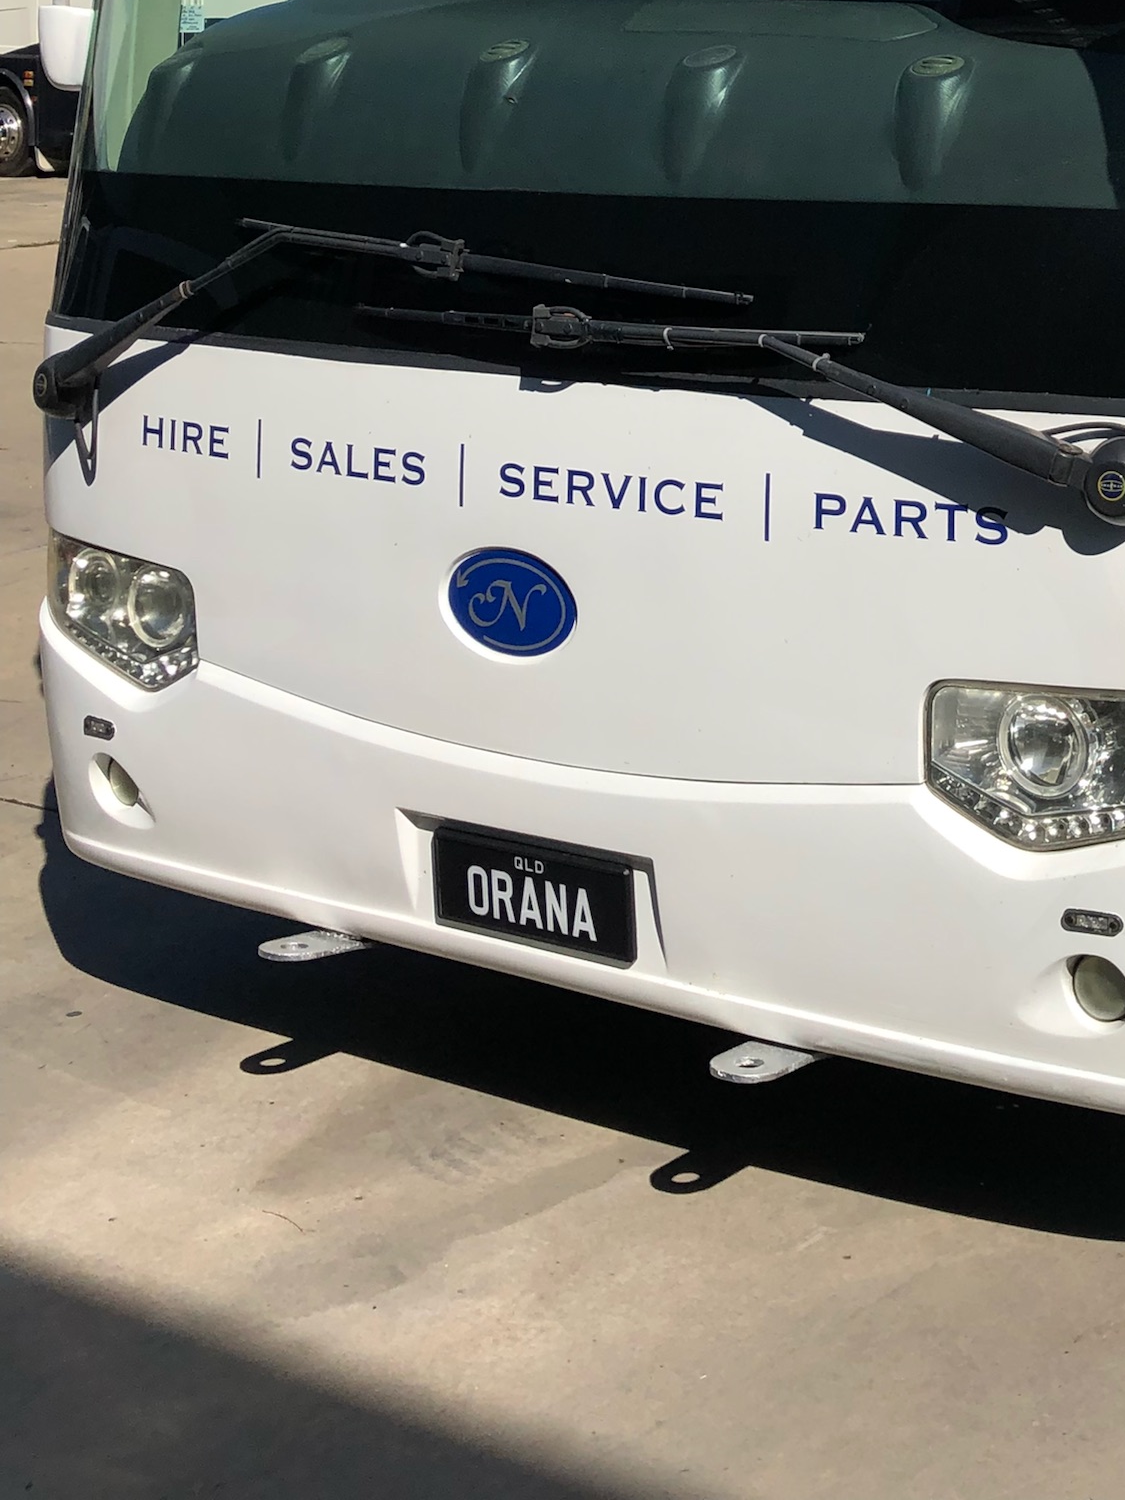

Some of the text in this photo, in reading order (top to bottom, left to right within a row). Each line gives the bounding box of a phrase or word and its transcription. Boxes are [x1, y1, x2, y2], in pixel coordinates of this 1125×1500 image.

[142, 415, 1010, 546] HIRE SALES SERVICE PARTS
[467, 865, 598, 942] ORANA
[514, 856, 545, 874] QLD
